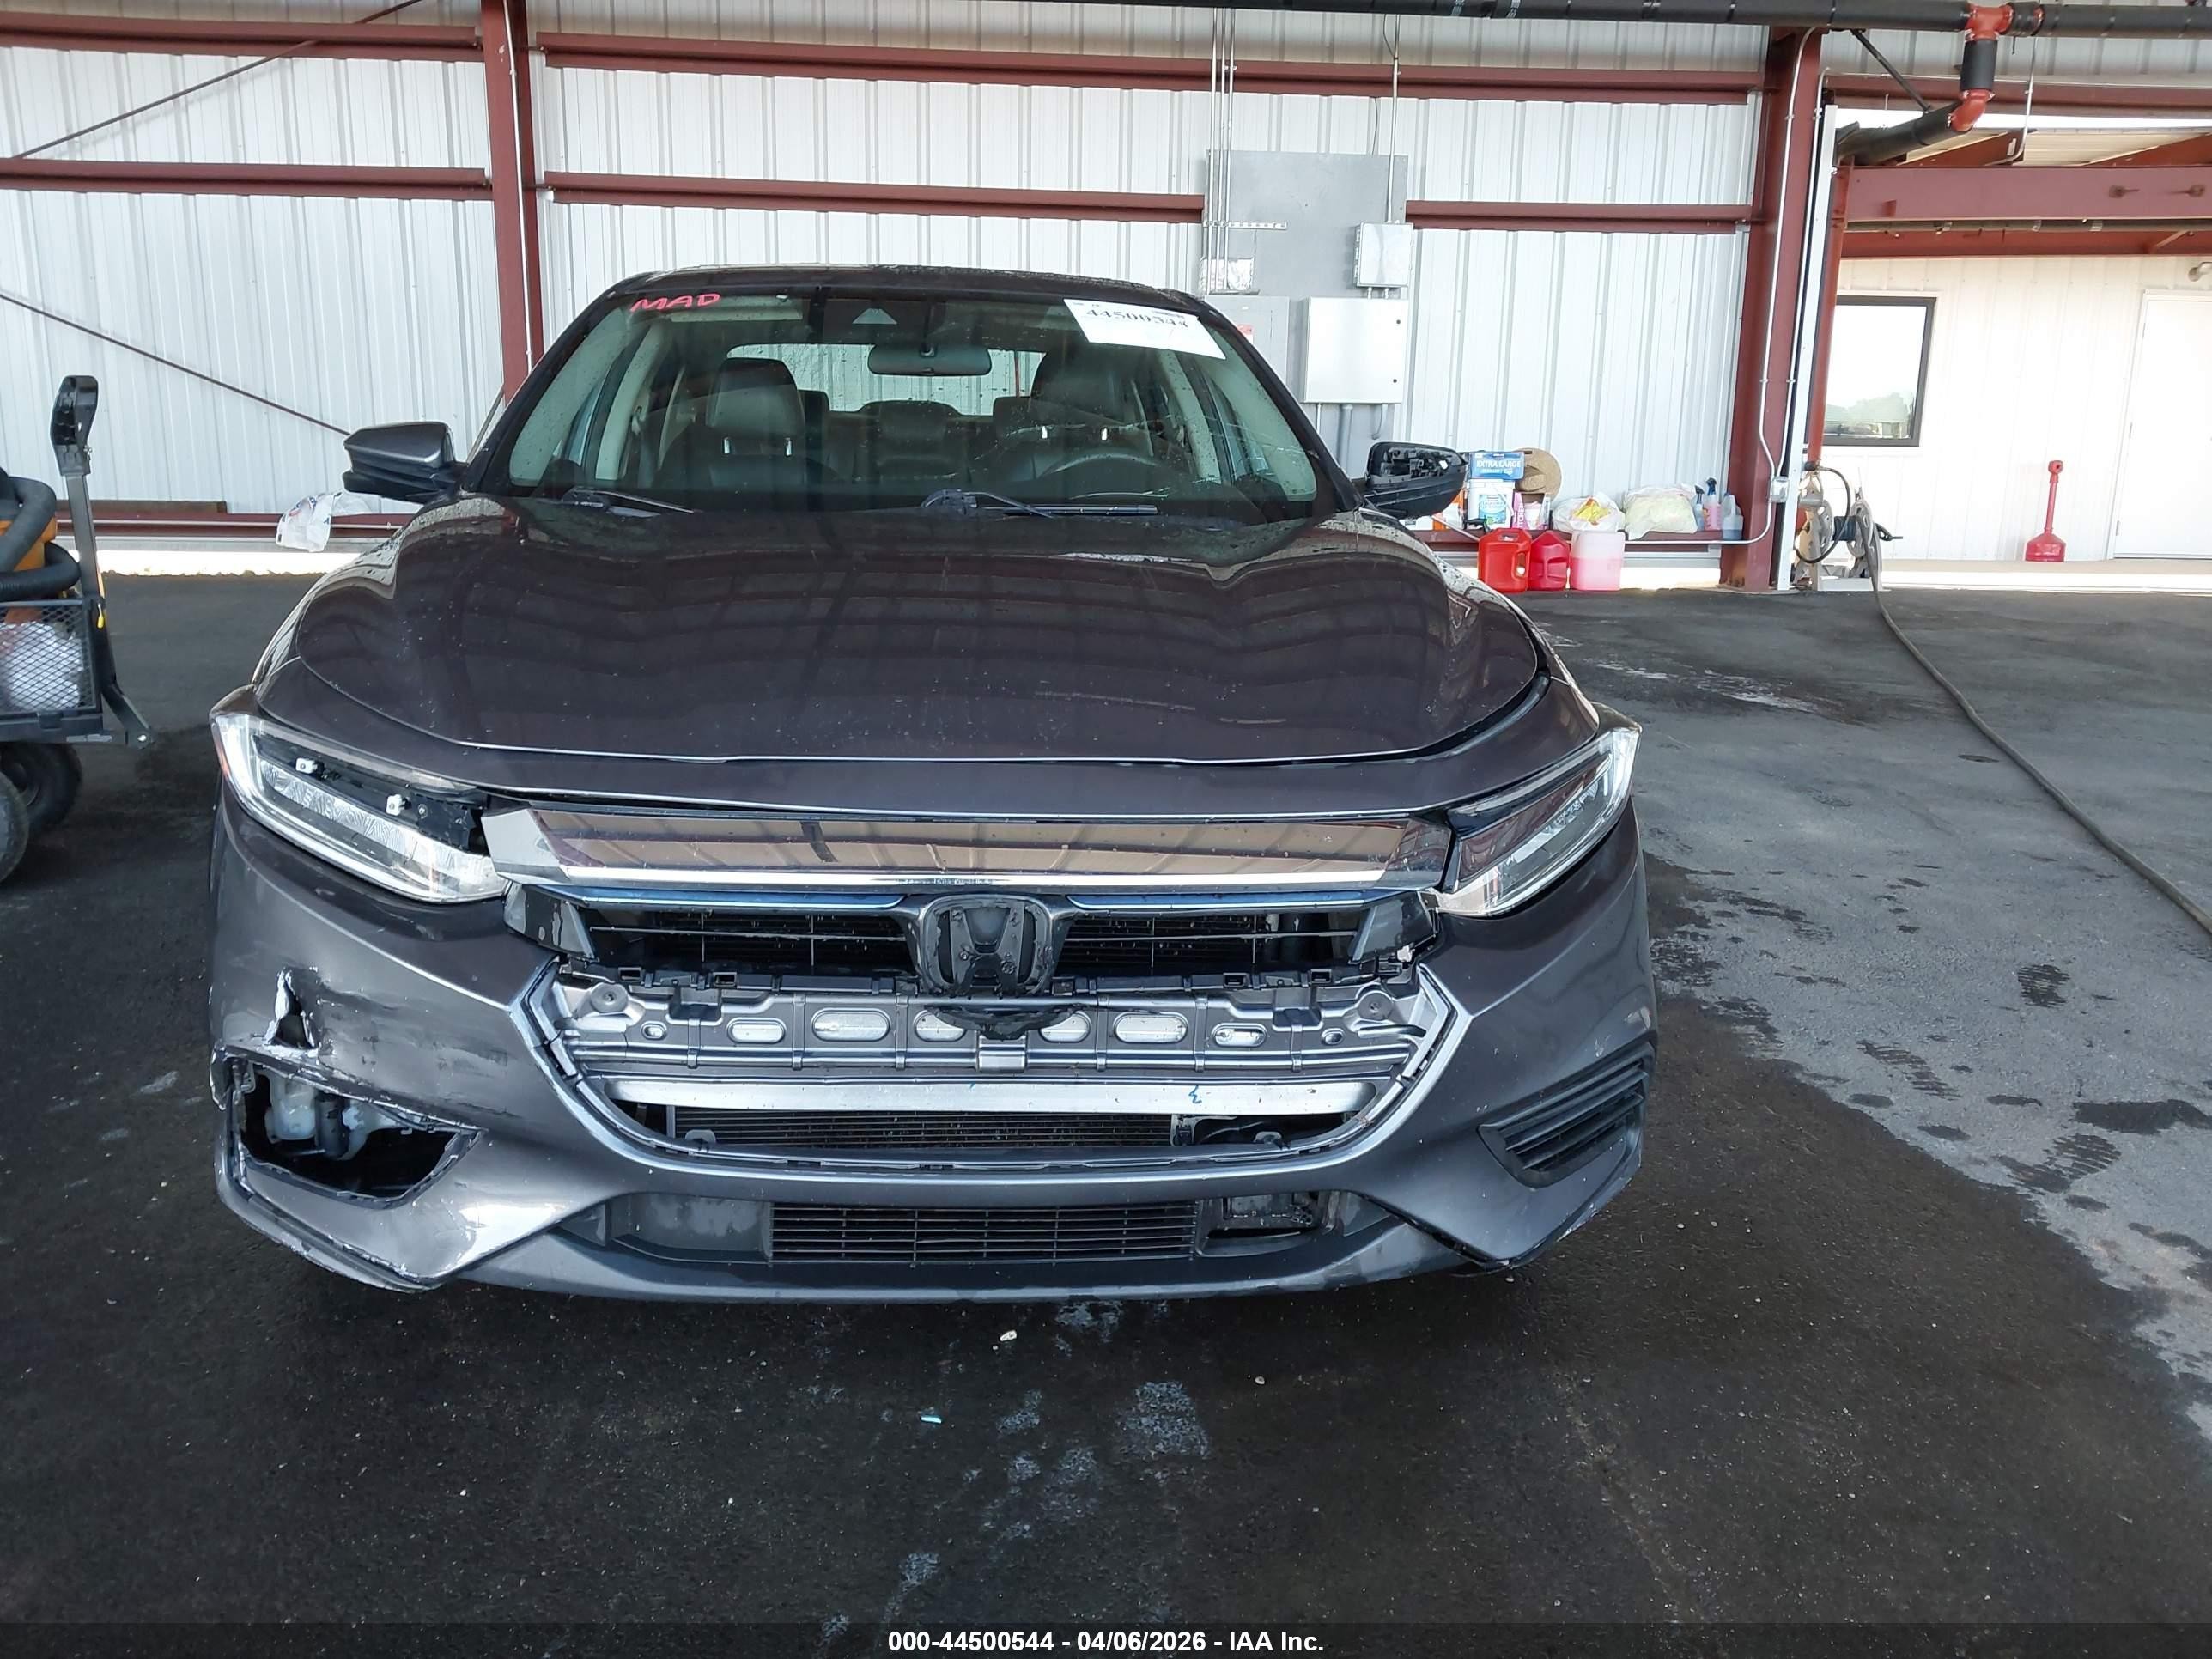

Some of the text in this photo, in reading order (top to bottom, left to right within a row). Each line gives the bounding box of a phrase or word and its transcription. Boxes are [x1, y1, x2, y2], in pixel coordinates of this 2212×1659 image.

[630, 293, 721, 312] MAD
[1476, 459, 1522, 468] EXTRA LARGE
